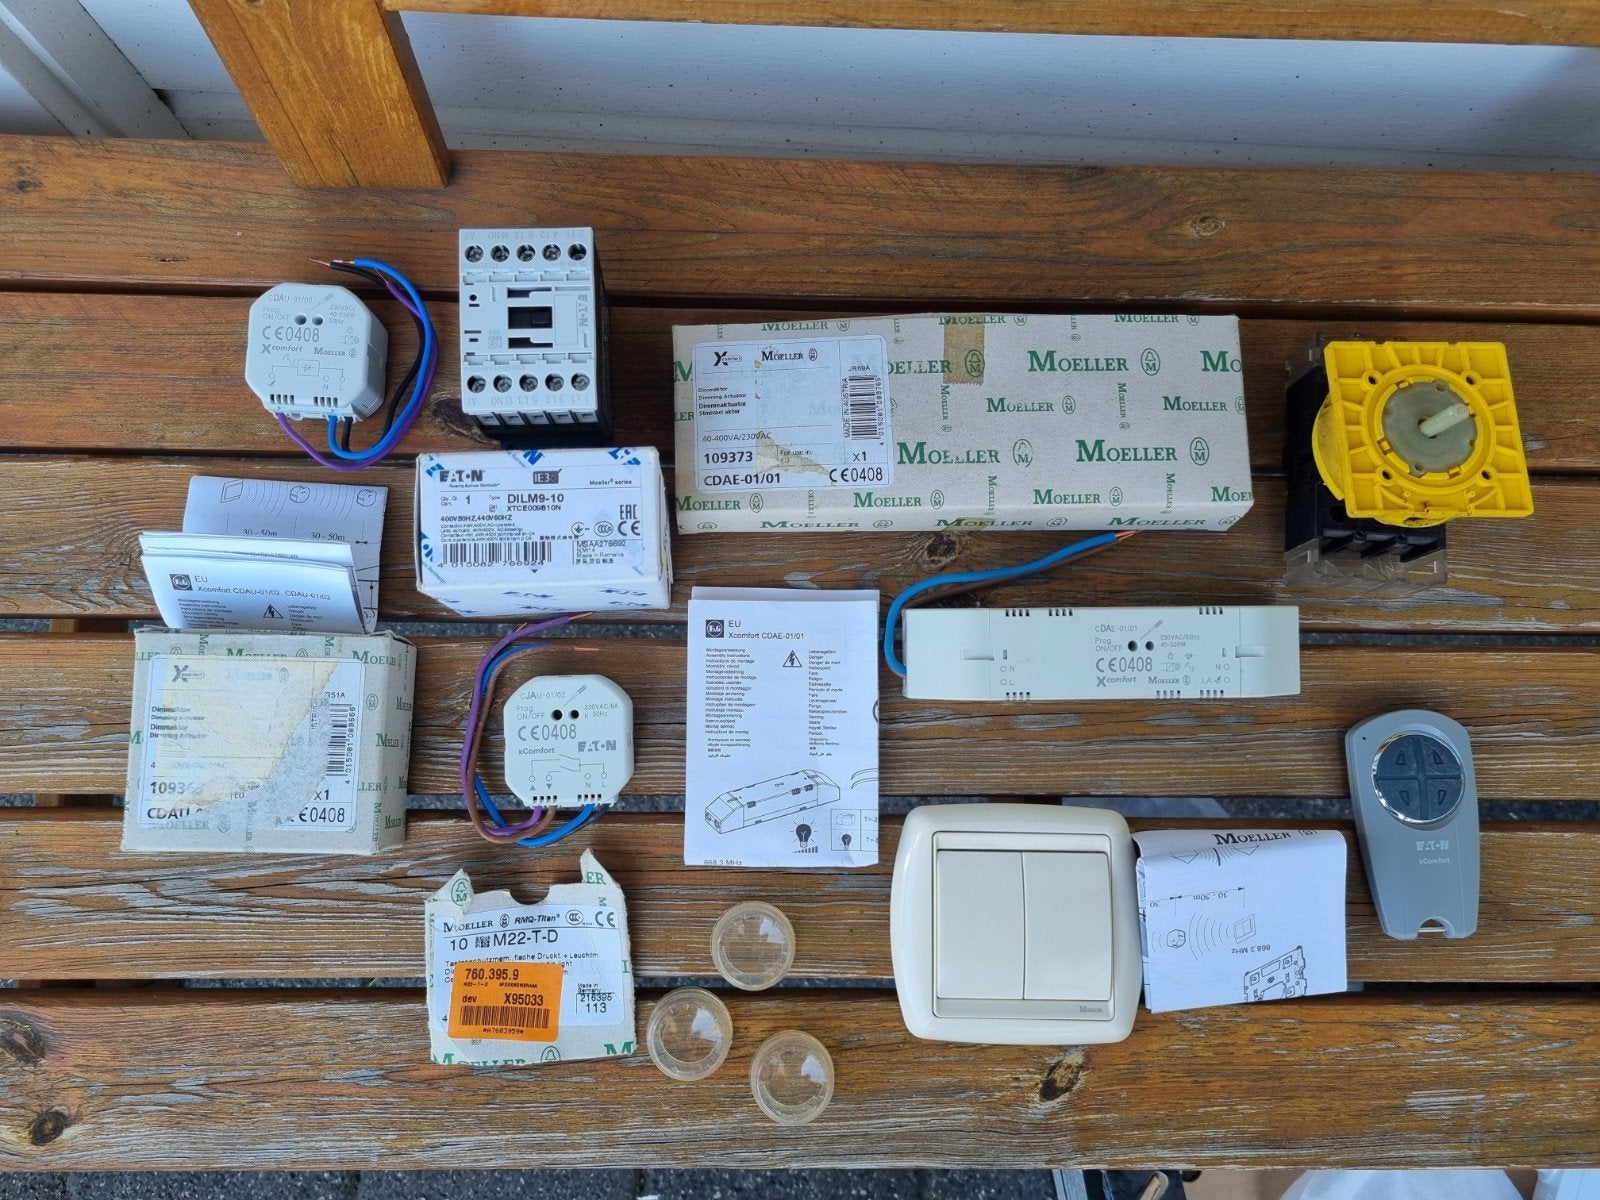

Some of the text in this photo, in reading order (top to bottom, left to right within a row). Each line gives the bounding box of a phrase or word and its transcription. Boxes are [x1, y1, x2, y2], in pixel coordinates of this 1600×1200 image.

[761, 321, 829, 332] MOELLER
[761, 350, 804, 361] MOELLER
[1027, 350, 1129, 373] MOELLER
[940, 385, 950, 421] MOELLER
[986, 397, 1055, 413] MOELLER
[1162, 395, 1228, 412] MOELLER
[1075, 438, 1178, 463] MOELLER
[703, 451, 753, 464] 109373
[703, 472, 781, 487] CDAE-01/01
[465, 495, 471, 505] 1
[507, 493, 565, 504] DILM9-10
[853, 491, 922, 509] MOELLER
[1033, 488, 1101, 505] MOELLER
[676, 495, 741, 512] MOELLER
[759, 520, 860, 530] MOELLER
[327, 532, 346, 542] 50m
[197, 586, 232, 595] Xcomfort
[729, 620, 741, 628] EU
[728, 631, 805, 640] Xcomfort CDAE-01/01
[518, 747, 556, 756] xComfort
[1212, 832, 1292, 846] MOELLER
[450, 938, 468, 951] 10
[493, 929, 559, 947] M22-T-D
[465, 968, 519, 981] 760.395.9
[462, 993, 544, 1006] dev X95033
[586, 1002, 607, 1013] 113
